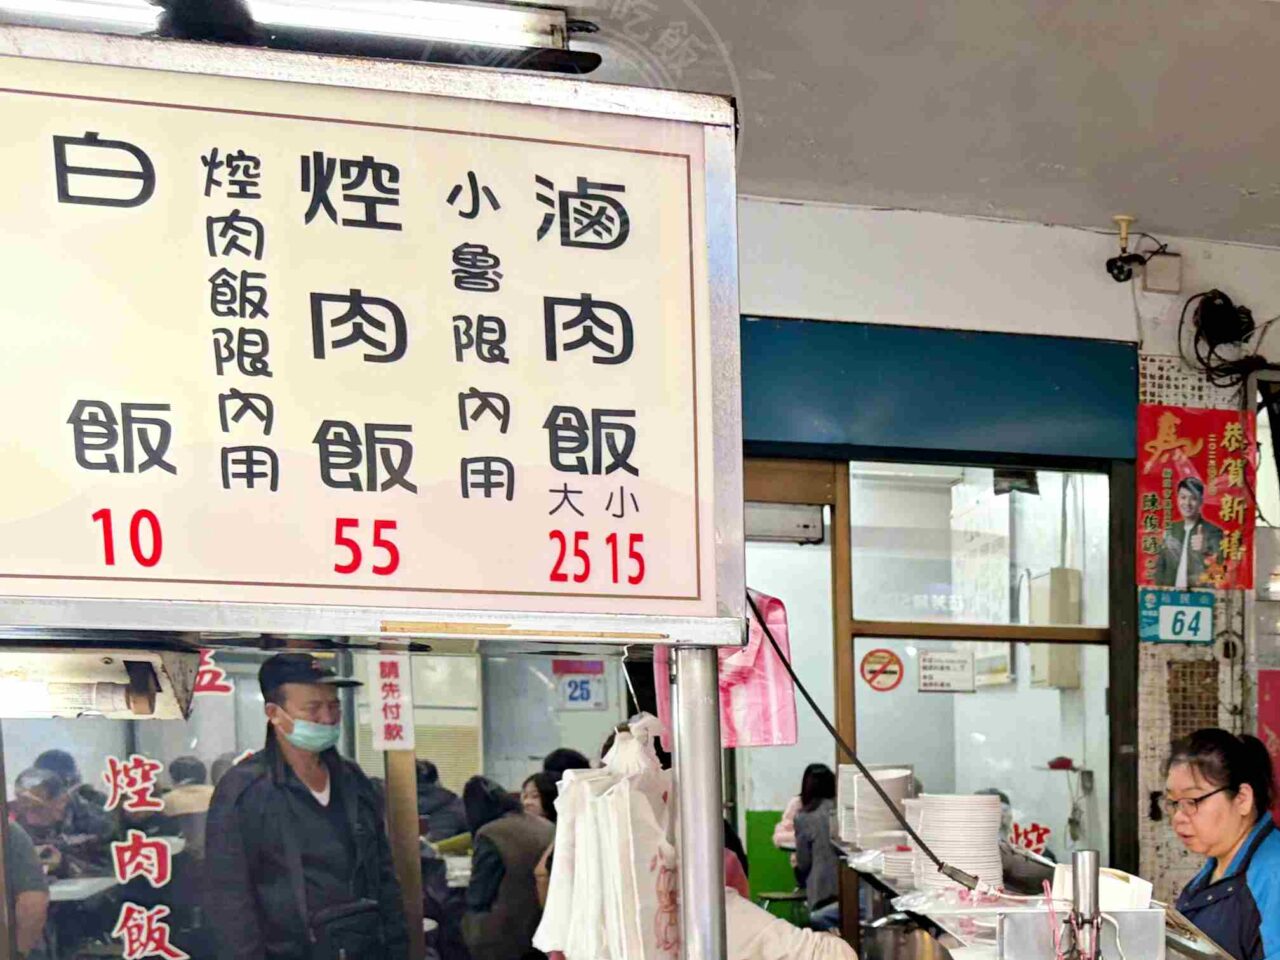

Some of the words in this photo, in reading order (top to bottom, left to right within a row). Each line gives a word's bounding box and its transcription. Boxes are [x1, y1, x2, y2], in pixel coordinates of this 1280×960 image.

[53, 132, 176, 474] 白飯
[301, 152, 417, 493] 焢肉飯
[447, 171, 514, 500] 小魯限內用
[536, 175, 638, 476] 滷肉飯
[550, 484, 583, 516] 大
[606, 487, 638, 518] 小
[1220, 421, 1248, 561] 恭賀新禧
[93, 509, 162, 566] 10
[335, 518, 399, 575] 55
[550, 530, 590, 582] 25
[606, 533, 644, 584] 15
[1172, 611, 1202, 637] 64
[379, 660, 404, 741] 請先付款
[567, 680, 591, 701] 25
